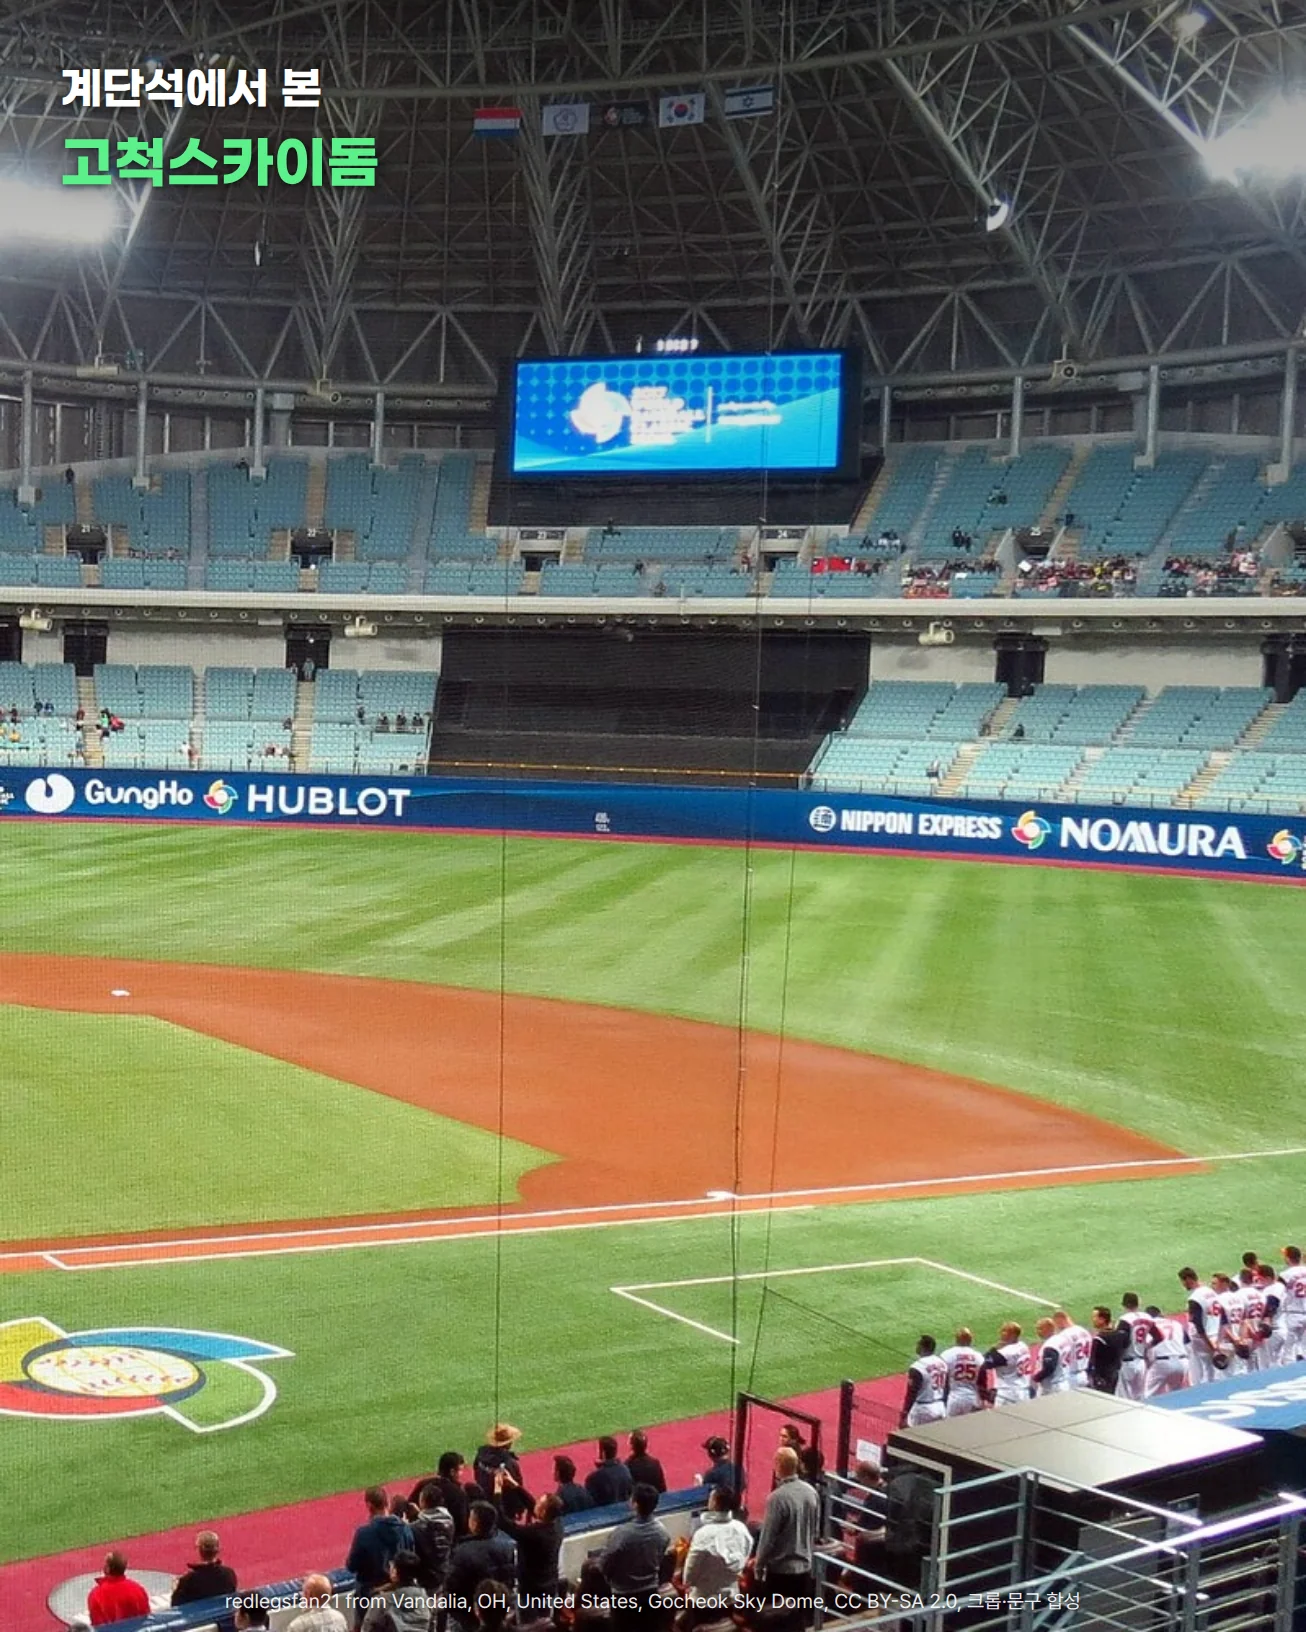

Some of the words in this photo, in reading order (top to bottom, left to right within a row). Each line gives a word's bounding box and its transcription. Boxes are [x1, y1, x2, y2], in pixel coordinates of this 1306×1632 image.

[84, 778, 194, 811] GungHo
[247, 783, 412, 817] HUBLOT
[841, 809, 913, 834] NIPPON
[918, 813, 1003, 840] EXPRESS
[1060, 816, 1248, 860] NOMURA
[954, 1364, 977, 1381] 25
